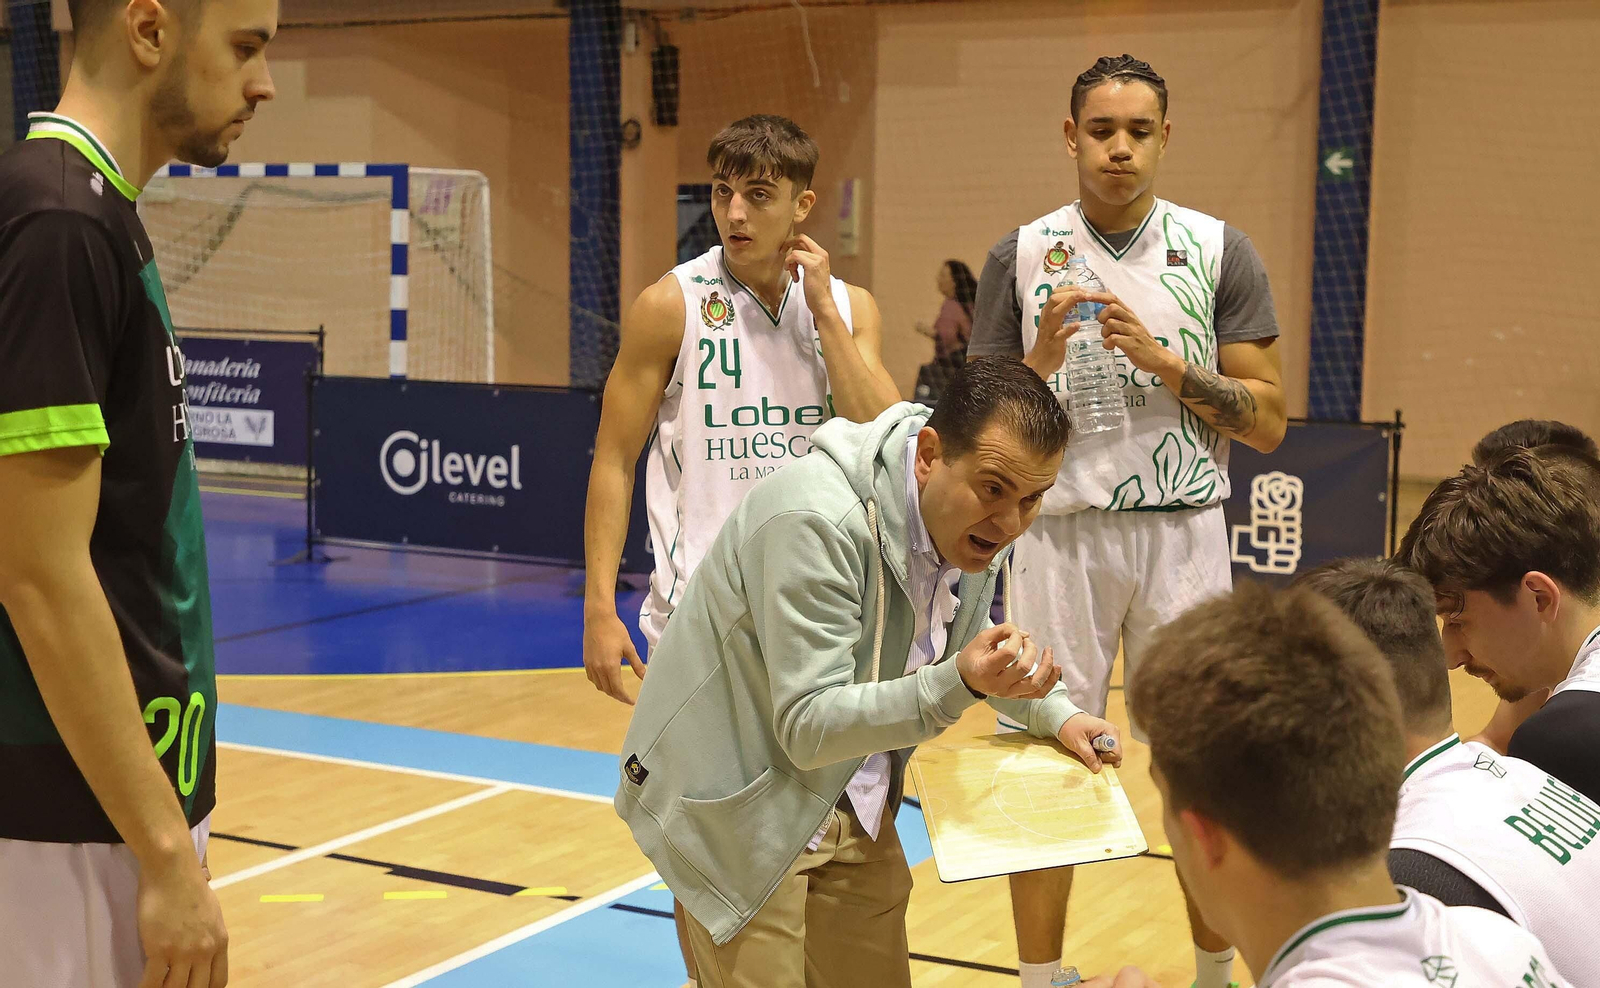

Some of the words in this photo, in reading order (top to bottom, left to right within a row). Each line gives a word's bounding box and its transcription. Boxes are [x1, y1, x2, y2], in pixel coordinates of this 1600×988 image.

[697, 337, 741, 389] 24
[704, 397, 824, 428] Lobe
[755, 464, 784, 480] Ma
[448, 491, 505, 507] CATERING
[143, 691, 206, 797] 20
